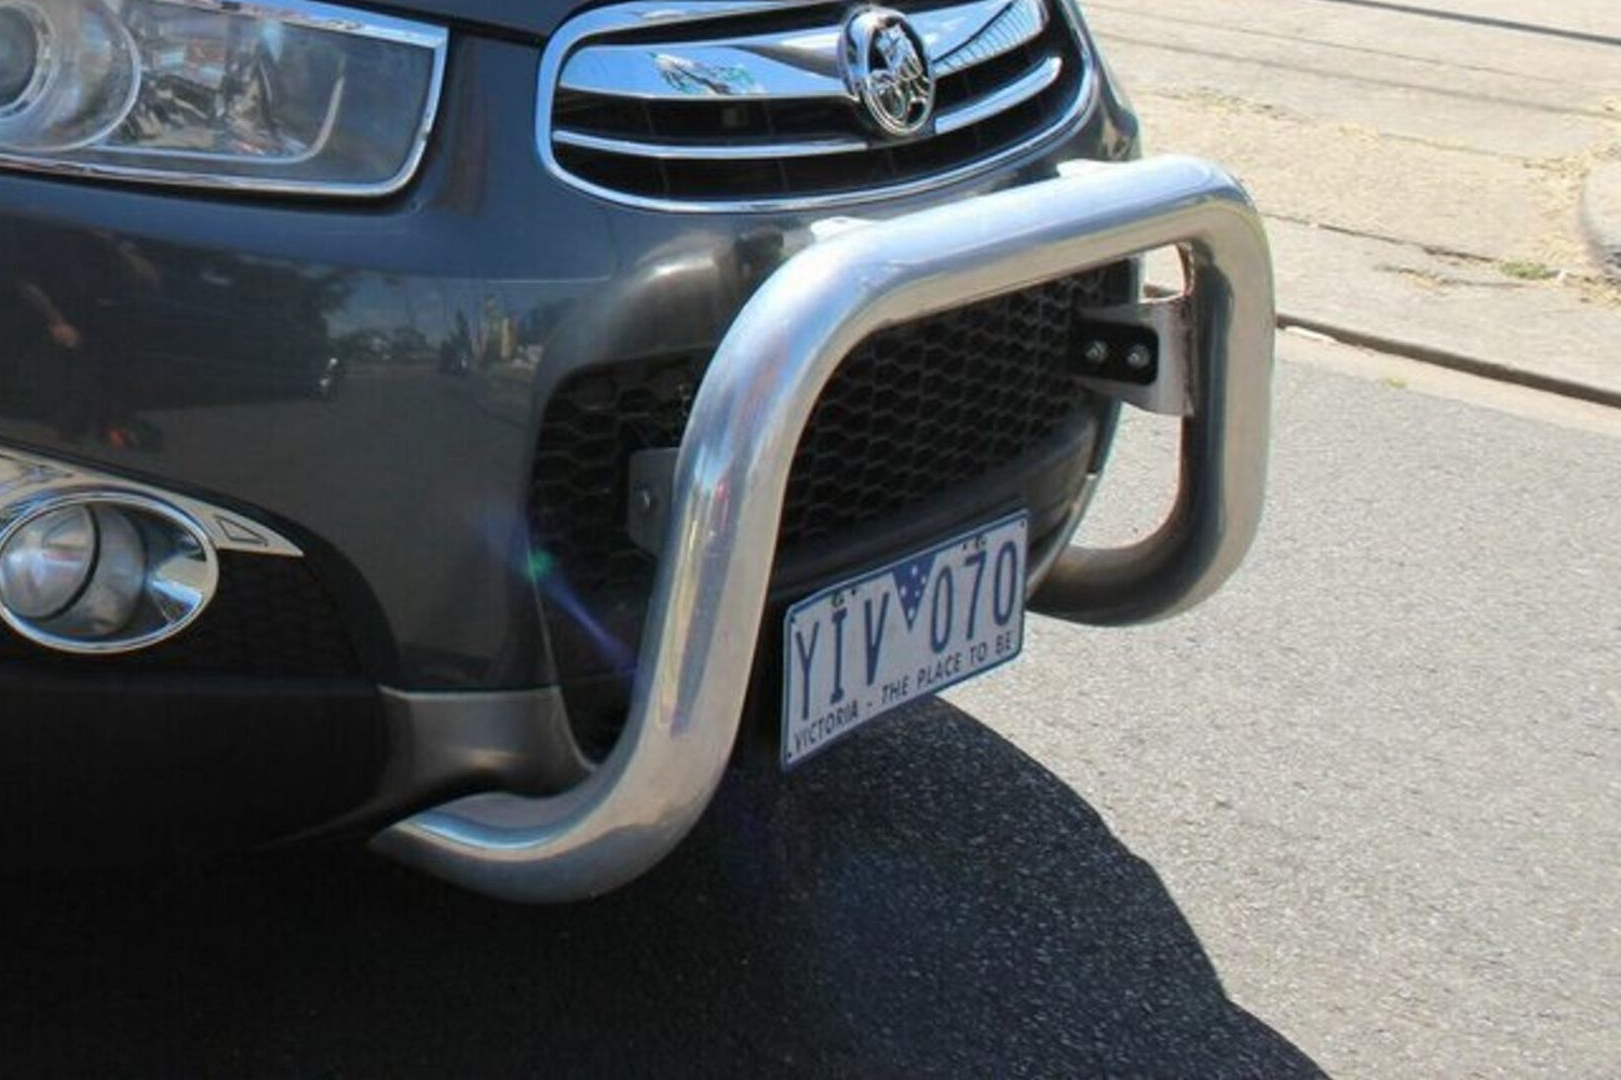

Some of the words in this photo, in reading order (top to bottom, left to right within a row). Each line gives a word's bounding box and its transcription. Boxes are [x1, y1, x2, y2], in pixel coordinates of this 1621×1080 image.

[930, 539, 1018, 654] 070
[793, 700, 859, 753] VICTORIA
[881, 677, 910, 704] THE
[917, 652, 963, 689] PLACE
[970, 642, 988, 664] TO
[995, 631, 1012, 656] BE
